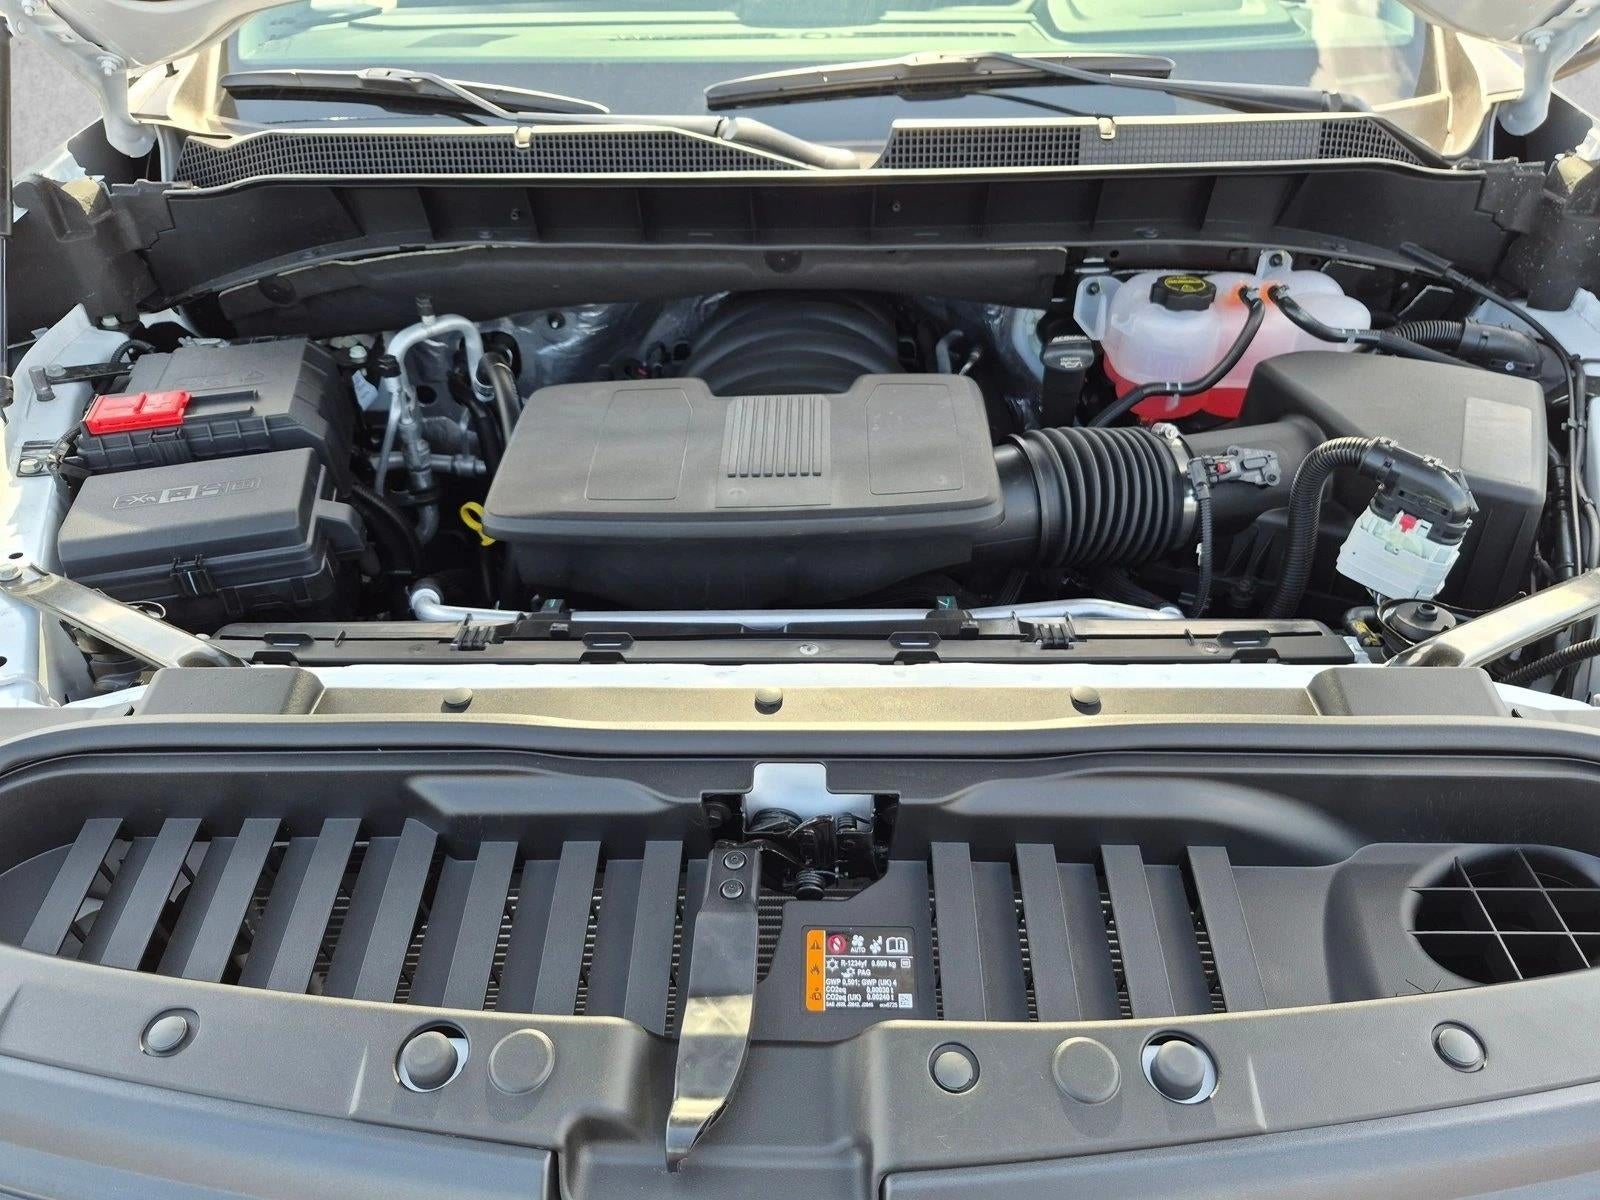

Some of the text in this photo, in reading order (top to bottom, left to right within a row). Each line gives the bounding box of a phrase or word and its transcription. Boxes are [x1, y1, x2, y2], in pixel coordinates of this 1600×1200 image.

[840, 960, 867, 968] R-1234yf
[888, 960, 897, 969] kg
[878, 978, 892, 987] (UK)
[826, 986, 847, 994] CO2eq
[847, 994, 861, 1002] (UK)
